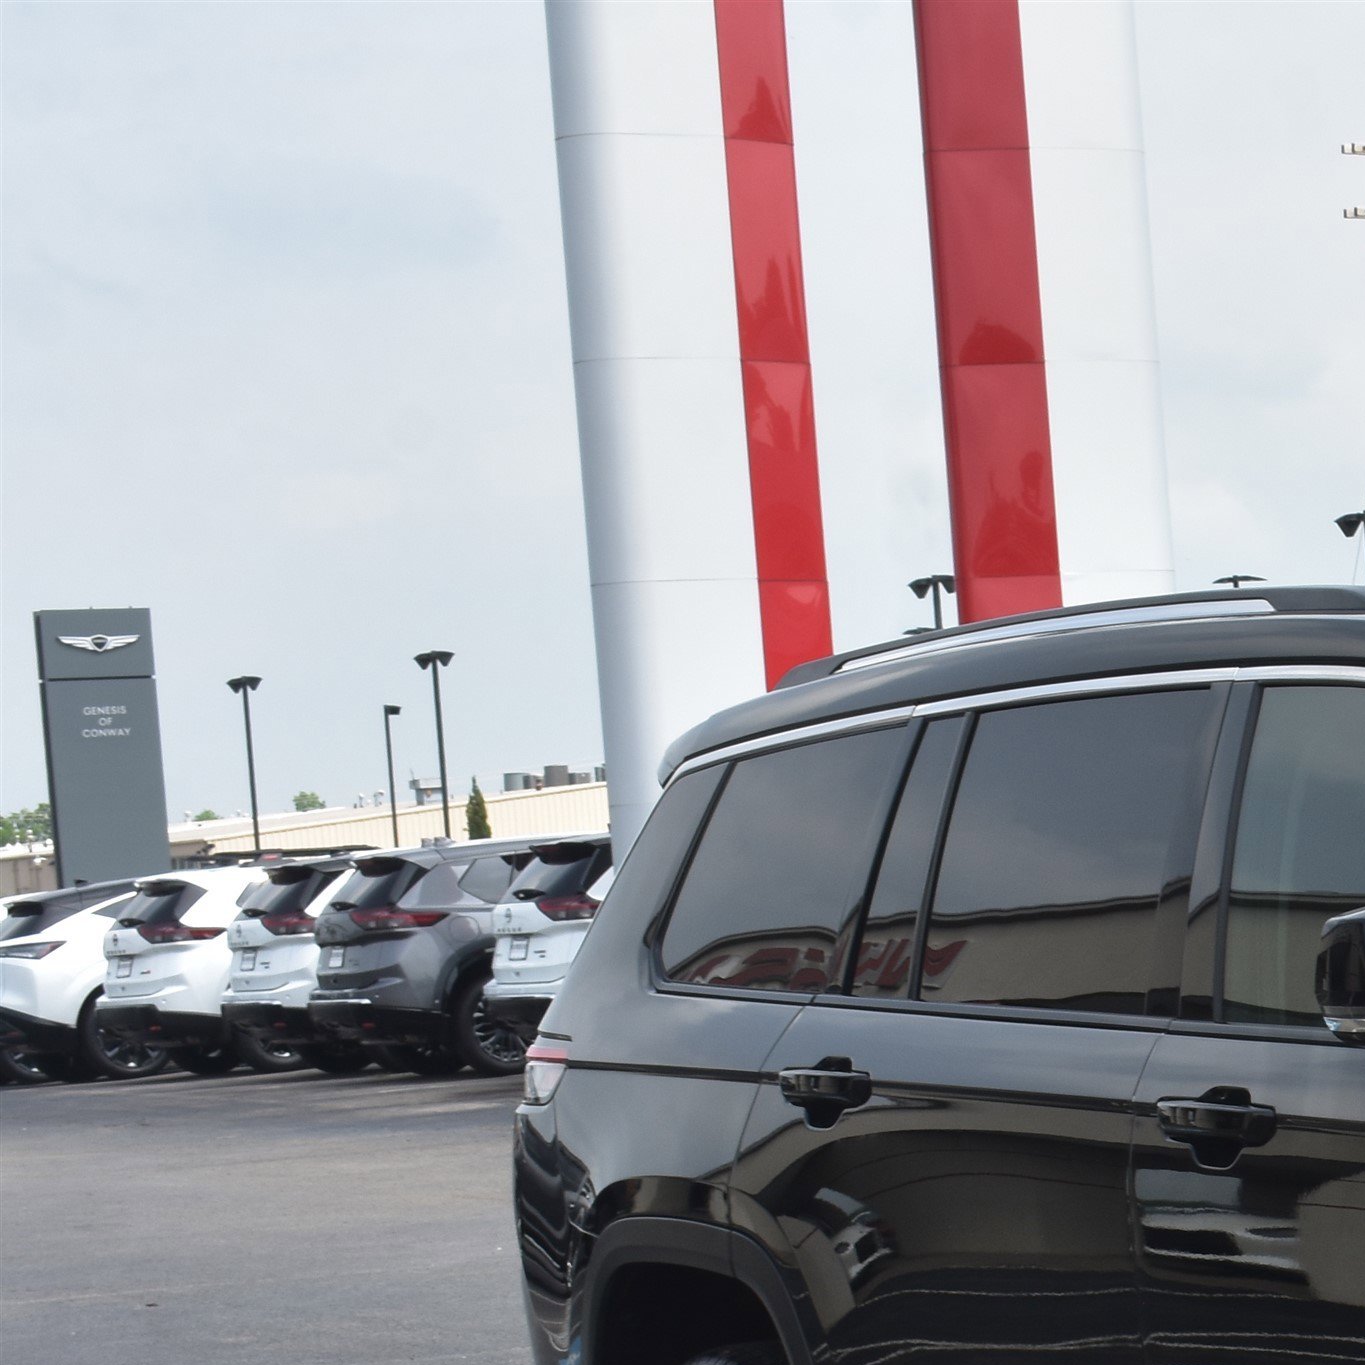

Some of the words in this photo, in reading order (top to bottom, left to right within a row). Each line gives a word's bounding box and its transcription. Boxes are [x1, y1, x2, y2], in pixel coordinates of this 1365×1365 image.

[83, 705, 127, 716] GENESIS
[98, 717, 113, 727] OF
[82, 727, 132, 738] CONWAY
